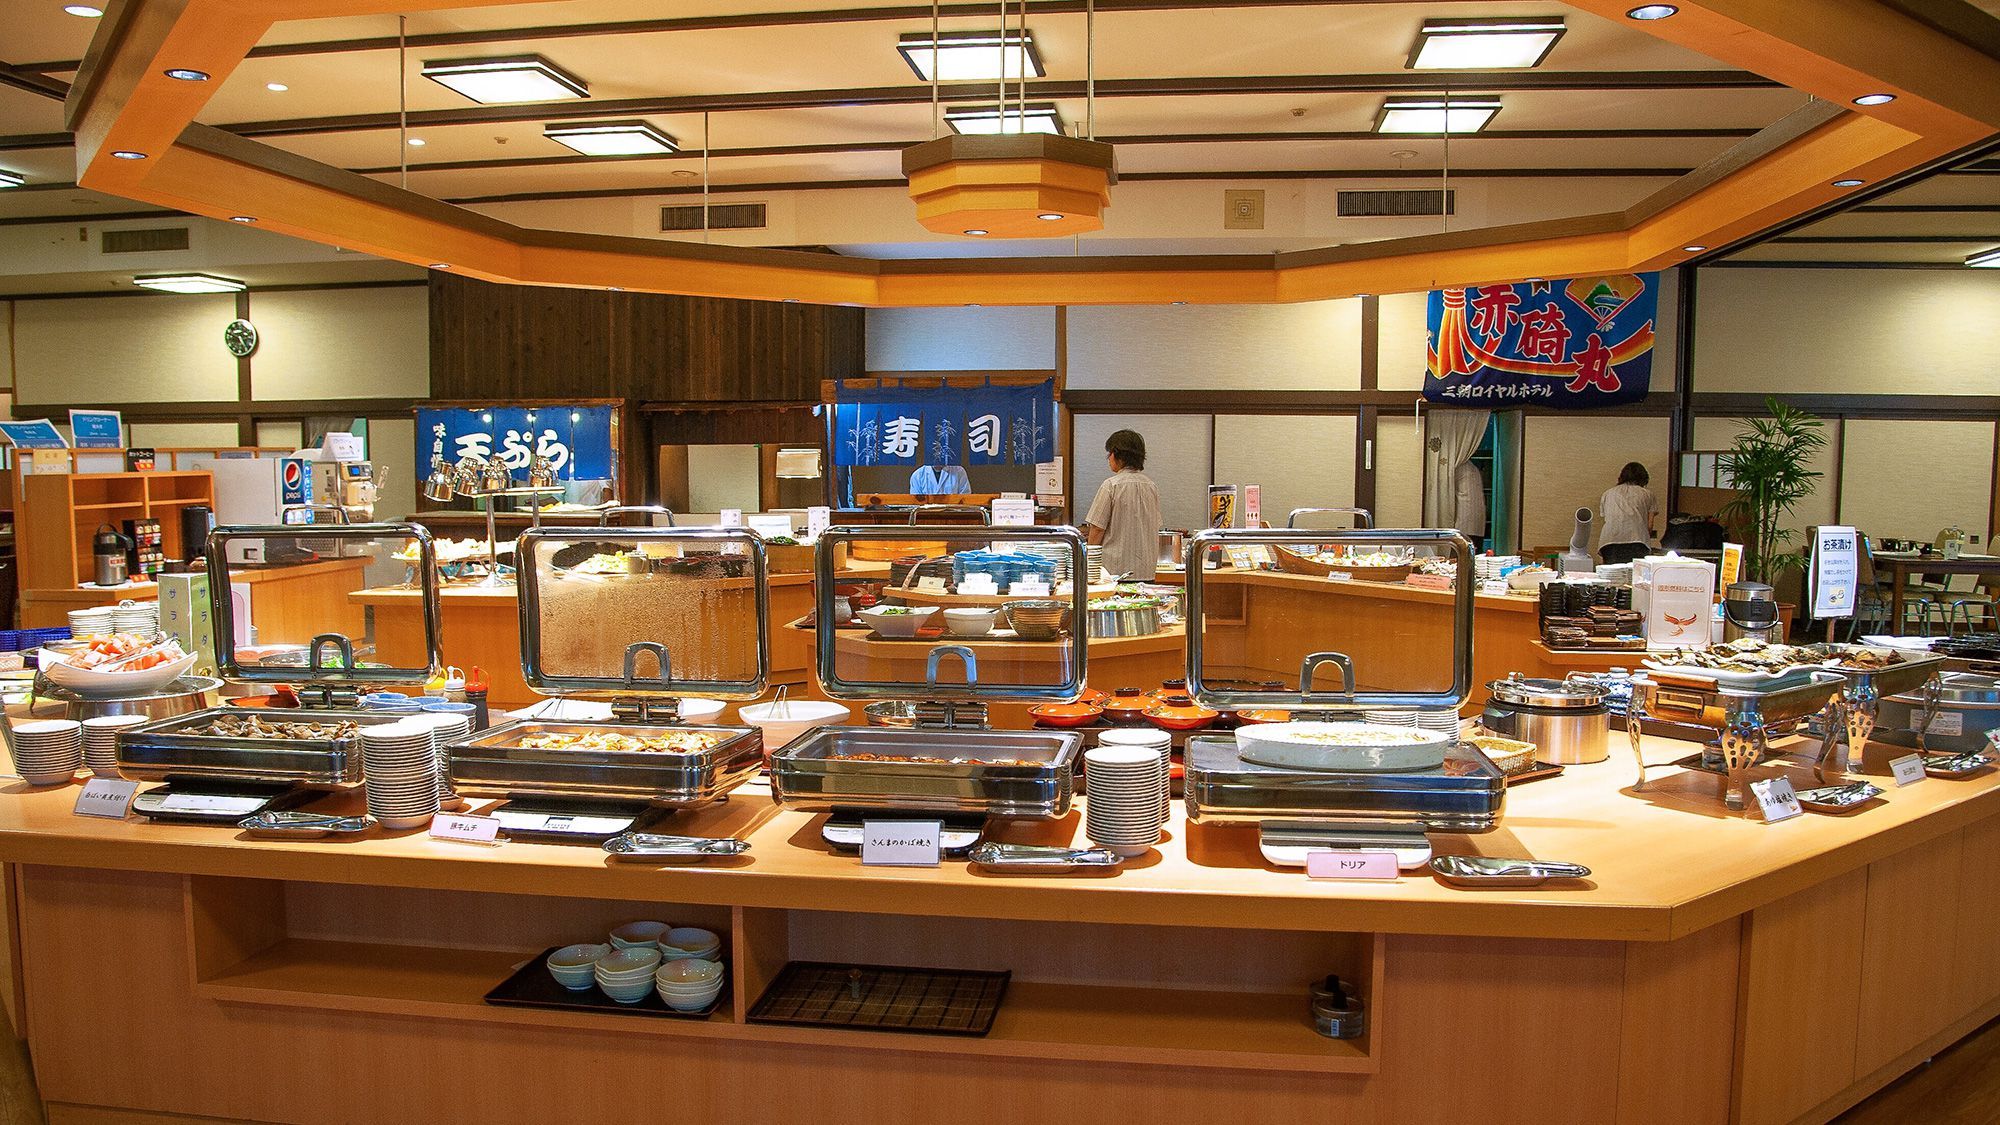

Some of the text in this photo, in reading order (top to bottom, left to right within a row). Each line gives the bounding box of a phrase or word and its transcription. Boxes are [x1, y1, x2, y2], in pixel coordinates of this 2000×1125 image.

[1441, 383, 1554, 399] 三朝ロイヤルホテル
[455, 429, 569, 471] 天ぷら
[286, 491, 301, 499] pepsi
[1823, 539, 1852, 550] お茶漬け
[871, 838, 931, 847] さんまのかば焼き
[1340, 861, 1366, 869] ドリア
